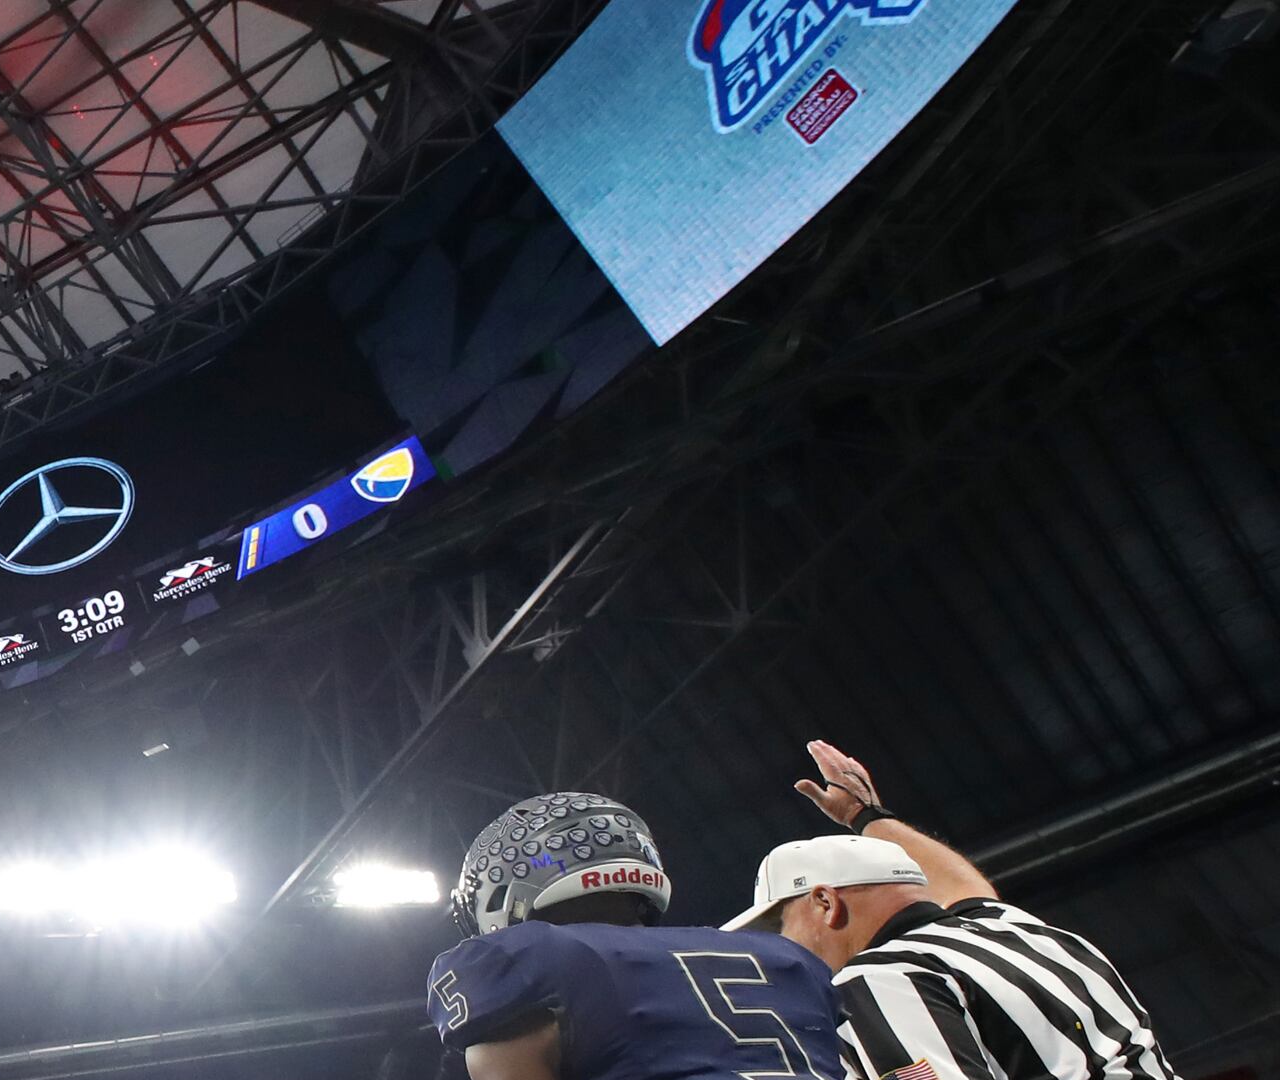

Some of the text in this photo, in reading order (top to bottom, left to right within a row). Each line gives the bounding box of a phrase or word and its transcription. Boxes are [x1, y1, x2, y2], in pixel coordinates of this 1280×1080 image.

[752, 58, 824, 135] PRESENTED
[292, 503, 328, 539] 0
[153, 563, 232, 602] Mercedes-Benz
[172, 577, 217, 601] STADIUM
[57, 590, 125, 633] 3:09
[71, 615, 125, 644] 1ST QTR
[581, 868, 665, 889] Riddell
[433, 970, 469, 1030] 5
